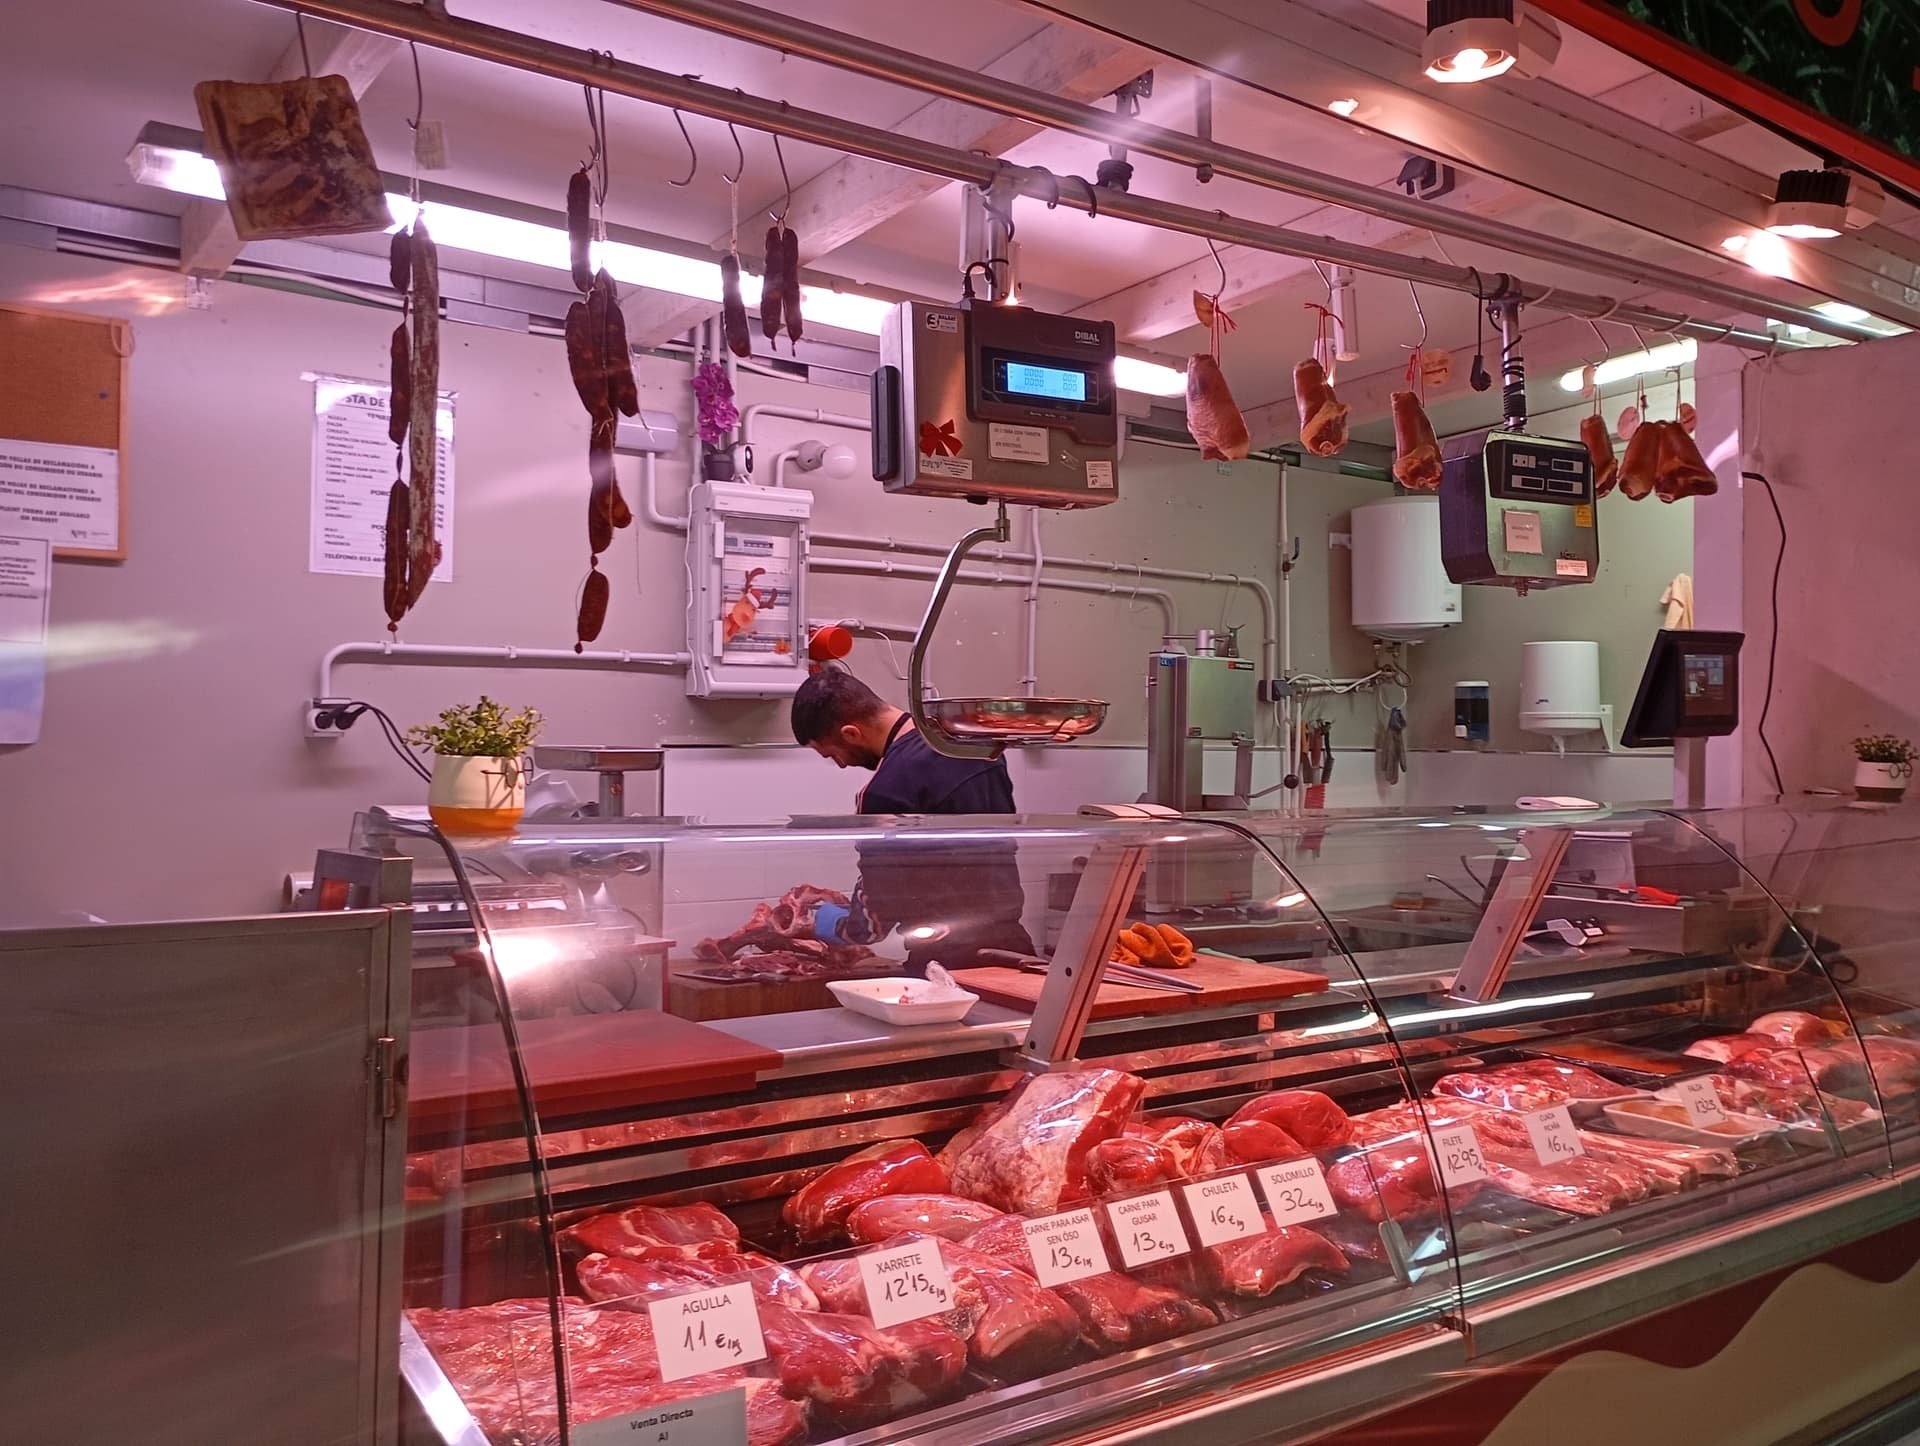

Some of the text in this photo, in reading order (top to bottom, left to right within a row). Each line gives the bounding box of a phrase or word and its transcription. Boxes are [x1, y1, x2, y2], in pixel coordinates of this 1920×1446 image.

[1074, 330, 1100, 342] DIBAL
[1442, 1136, 1464, 1146] FILETE
[1271, 1167, 1315, 1184] SOLOMILLO
[1202, 1181, 1239, 1197] CHULETA
[1118, 1198, 1161, 1215] CARNE PARA
[1025, 1214, 1090, 1235] CARNE PARA ASAR
[1132, 1212, 1158, 1226] GUISAR
[1047, 1235, 1062, 1246] SEN
[876, 1253, 922, 1274] XARRETE
[682, 1294, 731, 1314] AGULLA
[630, 1408, 694, 1430] Venta Directa
